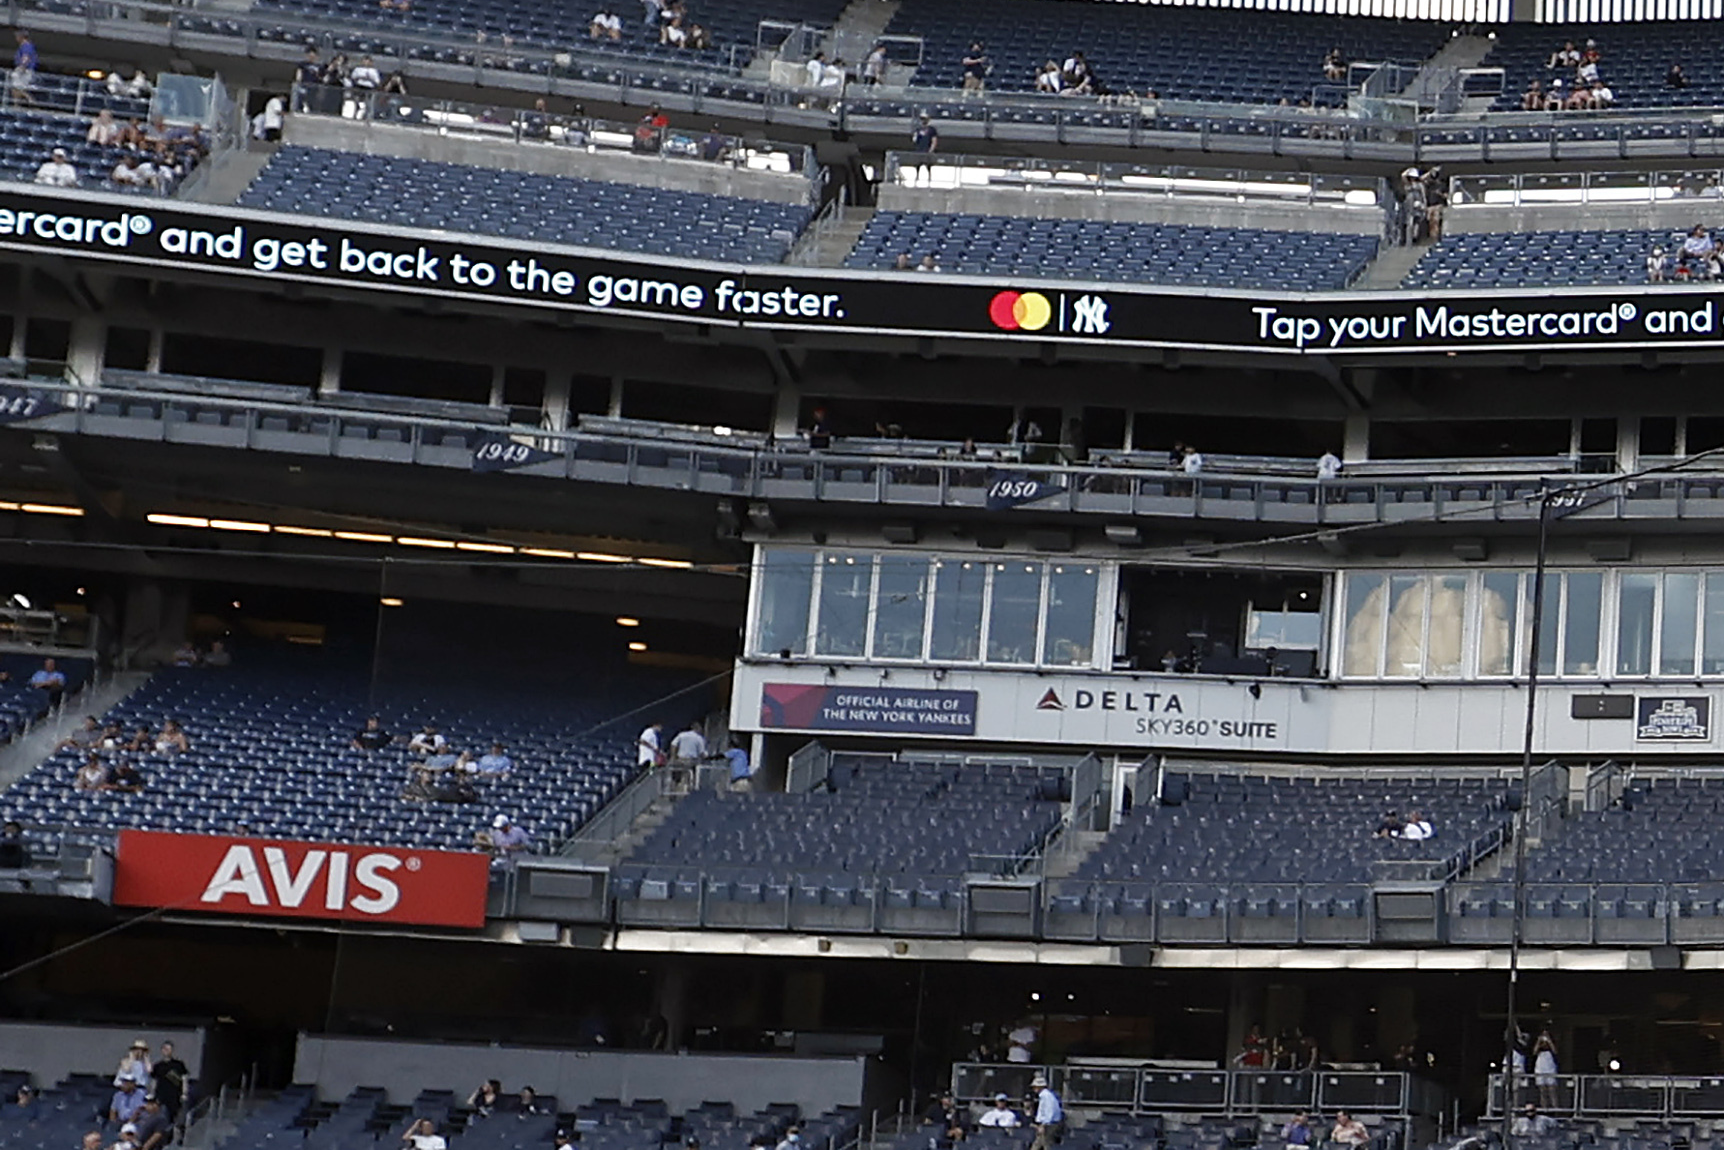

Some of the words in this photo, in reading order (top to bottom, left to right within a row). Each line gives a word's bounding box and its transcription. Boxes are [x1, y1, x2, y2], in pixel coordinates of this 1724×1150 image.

[159, 226, 243, 260] and
[252, 237, 328, 271] get
[340, 238, 438, 281] back
[449, 254, 496, 287] to
[506, 259, 576, 295] the
[587, 274, 704, 307] game
[715, 280, 845, 318] faster.
[1252, 307, 1321, 348] Tap
[1329, 315, 1406, 348] your
[1644, 301, 1713, 334] and
[476, 442, 530, 464] 1949
[989, 480, 1038, 498] 1950
[836, 695, 890, 709] OFFICIAL
[893, 697, 940, 711] AIRLINE
[942, 699, 961, 710] OF
[1074, 689, 1184, 714] DELTA
[823, 708, 845, 721] THE
[848, 709, 878, 722] NEW
[881, 711, 915, 724] YORK
[918, 713, 972, 726] YANKEES
